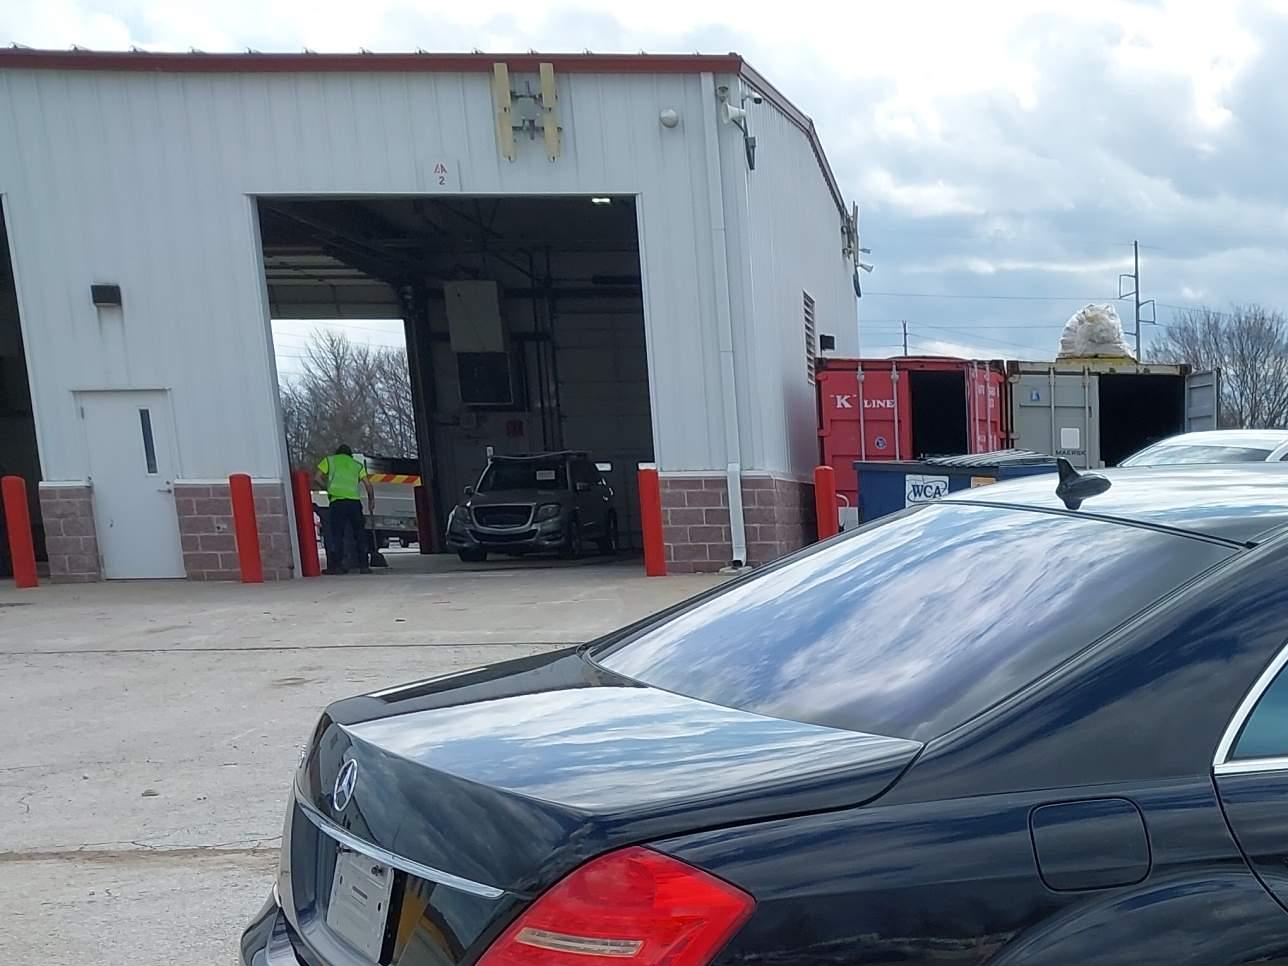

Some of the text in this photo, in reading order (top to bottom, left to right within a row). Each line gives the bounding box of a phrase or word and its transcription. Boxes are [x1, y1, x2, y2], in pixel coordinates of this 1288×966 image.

[439, 175, 446, 185] 2
[863, 399, 896, 408] LINE
[911, 484, 943, 499] WCA
